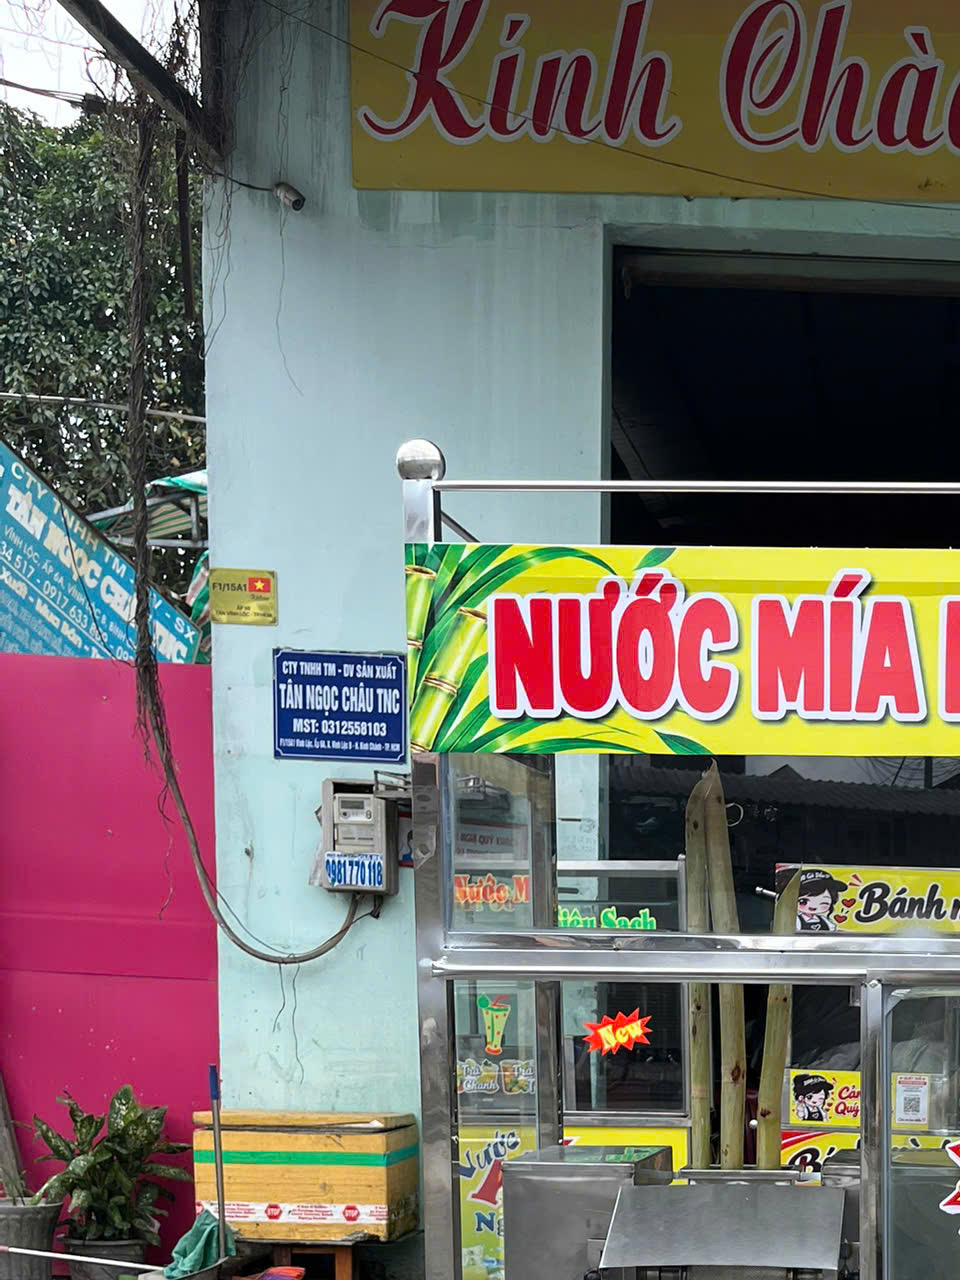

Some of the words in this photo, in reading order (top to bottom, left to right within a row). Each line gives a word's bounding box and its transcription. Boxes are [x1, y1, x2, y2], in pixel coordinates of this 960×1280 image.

[362, 0, 681, 141] Kính
[5, 483, 48, 540] TÂN
[43, 520, 102, 588] NGỌC
[11, 462, 47, 500] CTY
[53, 498, 99, 549] TNHH
[104, 549, 127, 578] TM
[174, 618, 196, 642] SX
[42, 583, 69, 610] 0917
[491, 571, 737, 716] NƯỚC
[755, 571, 923, 716] MÍA
[282, 660, 298, 675] CTY
[299, 661, 322, 676] TNHH
[323, 662, 336, 677] TM
[343, 663, 355, 678] DV
[355, 660, 374, 679] SẢN
[375, 661, 397, 680] XUẤT
[279, 678, 303, 709] TÂN
[305, 684, 339, 717] NGỌC
[341, 681, 374, 713] CHÂU
[376, 688, 400, 714] TNC
[292, 718, 319, 733] MST:
[321, 719, 387, 737] 0312558103
[854, 881, 947, 924] Bánh
[597, 1020, 643, 1049] New
